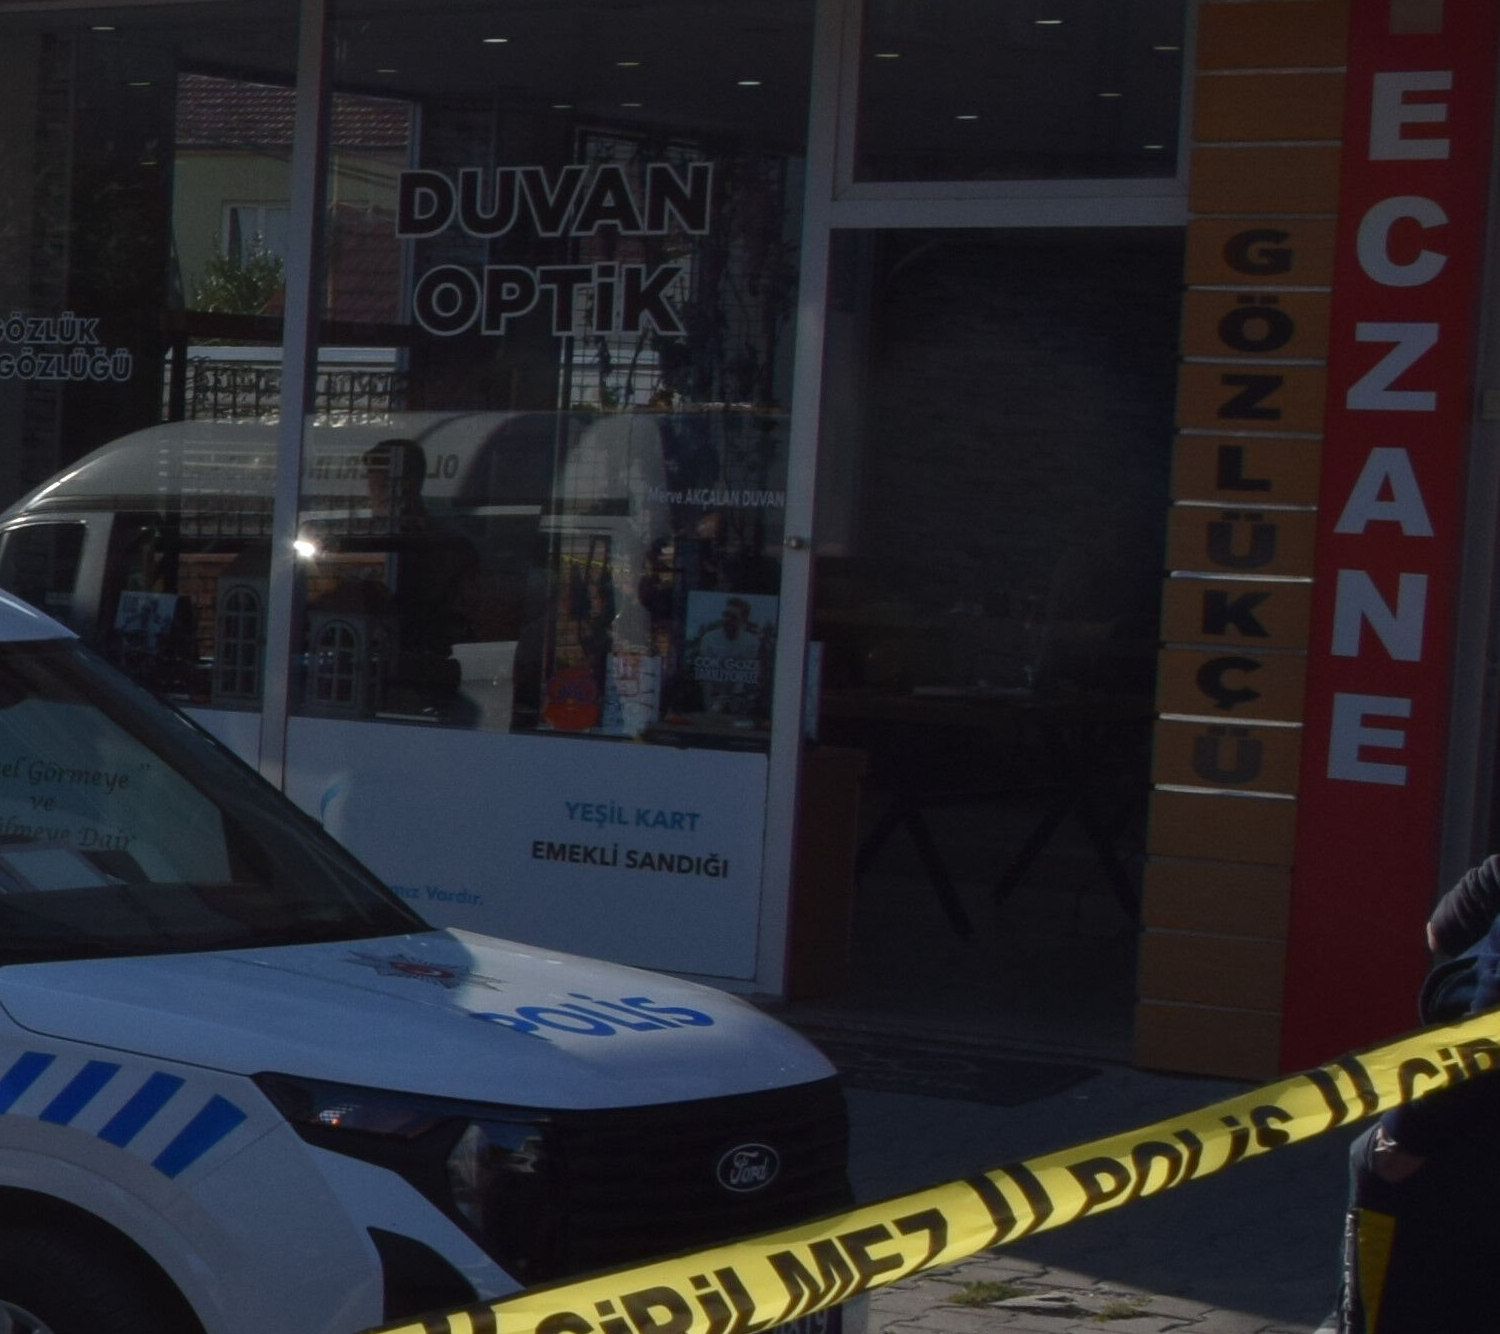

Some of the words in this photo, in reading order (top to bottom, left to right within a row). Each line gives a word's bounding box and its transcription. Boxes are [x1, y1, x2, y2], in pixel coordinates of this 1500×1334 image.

[396, 163, 714, 239] DUVAN
[413, 261, 687, 337] OPTİK
[1327, 69, 1453, 787] ECZANE
[1190, 228, 1295, 787] GÖZLÜKÇÜ
[27, 760, 130, 795] Görmeye
[29, 794, 55, 812] ve
[565, 799, 630, 829] YEŞİL
[635, 806, 701, 832] KART
[531, 839, 619, 868] EMEKLİ
[625, 851, 729, 879] SANDIĞI
[729, 1150, 771, 1186] Ford
